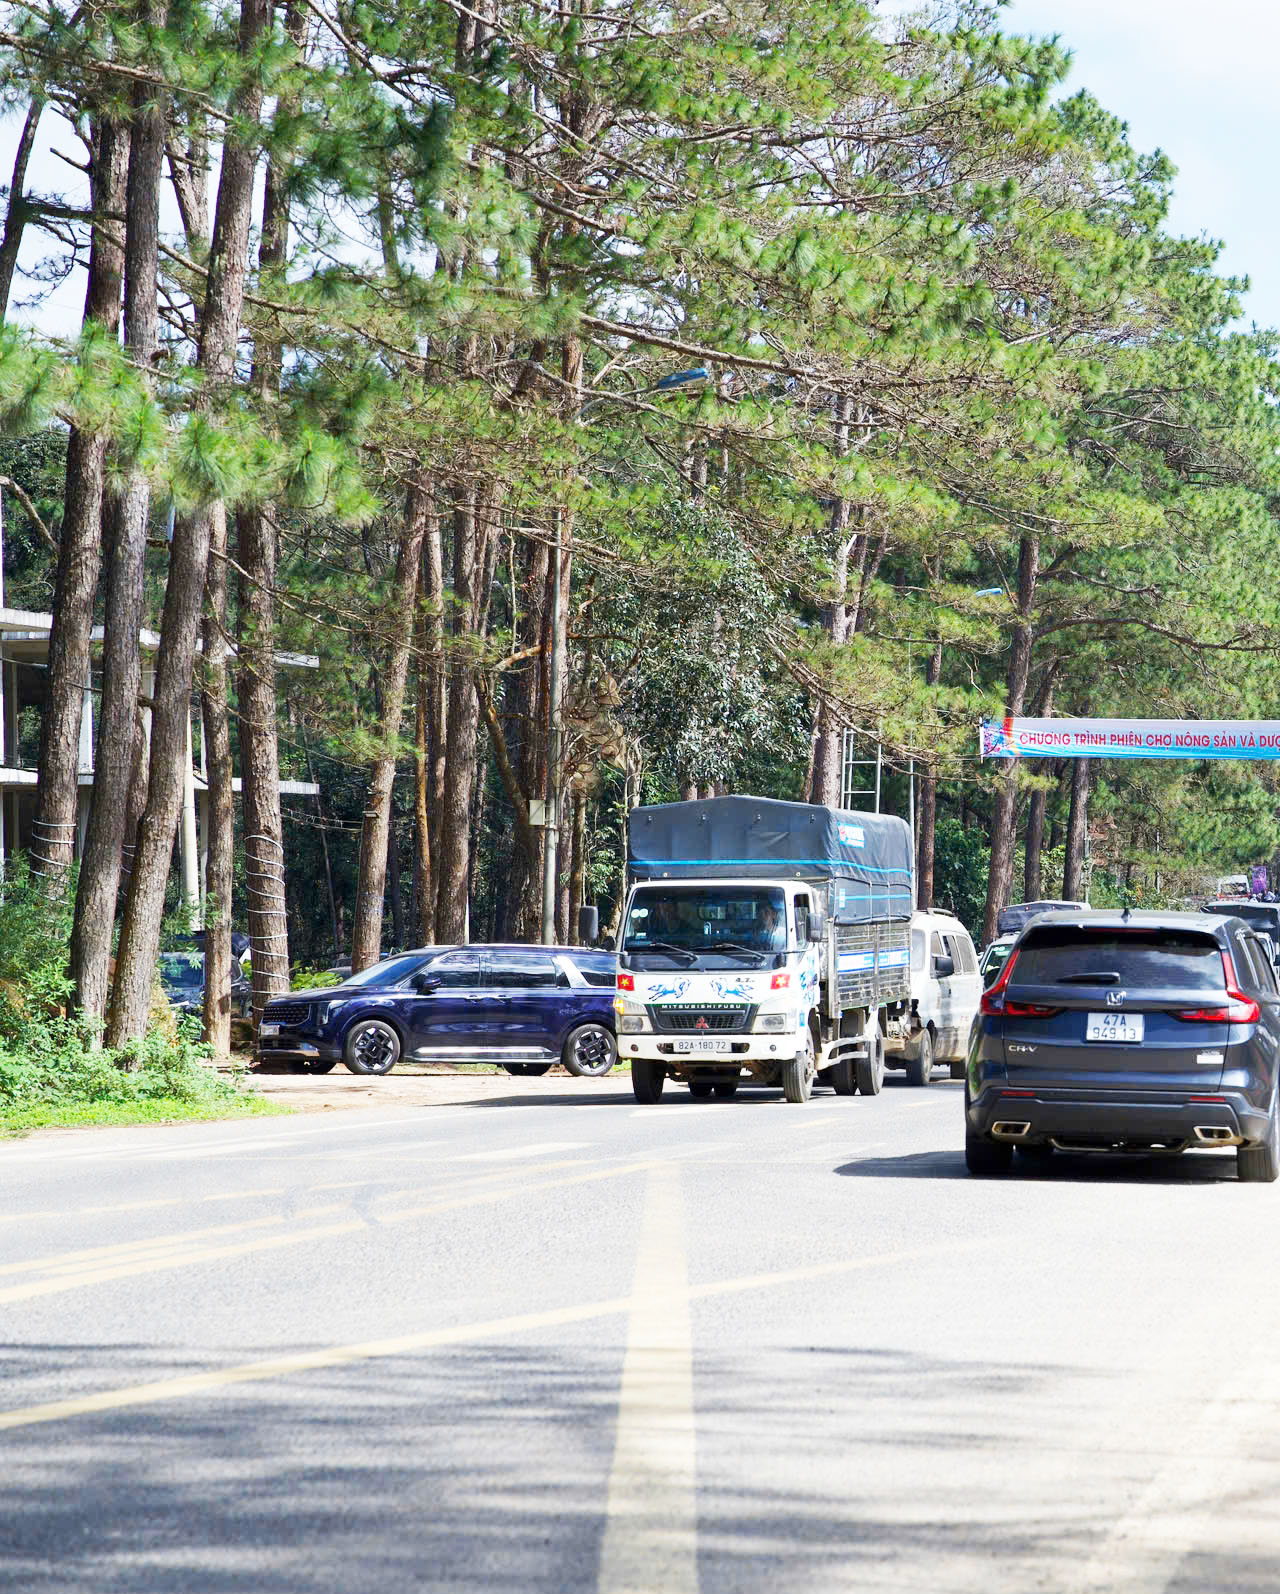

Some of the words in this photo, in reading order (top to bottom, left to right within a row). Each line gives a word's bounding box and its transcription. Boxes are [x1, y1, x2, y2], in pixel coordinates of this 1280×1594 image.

[1019, 731, 1071, 746] CHƯƠNG
[1074, 730, 1107, 746] TRÌNH
[1110, 731, 1142, 746] PHIÊN
[1145, 733, 1172, 750] CHỢ
[1175, 731, 1210, 747] NÔNG
[1213, 731, 1236, 747] SẢN
[1239, 731, 1256, 747] VÀ
[1103, 1014, 1127, 1027] 47A
[1092, 1027, 1137, 1040] 949.13
